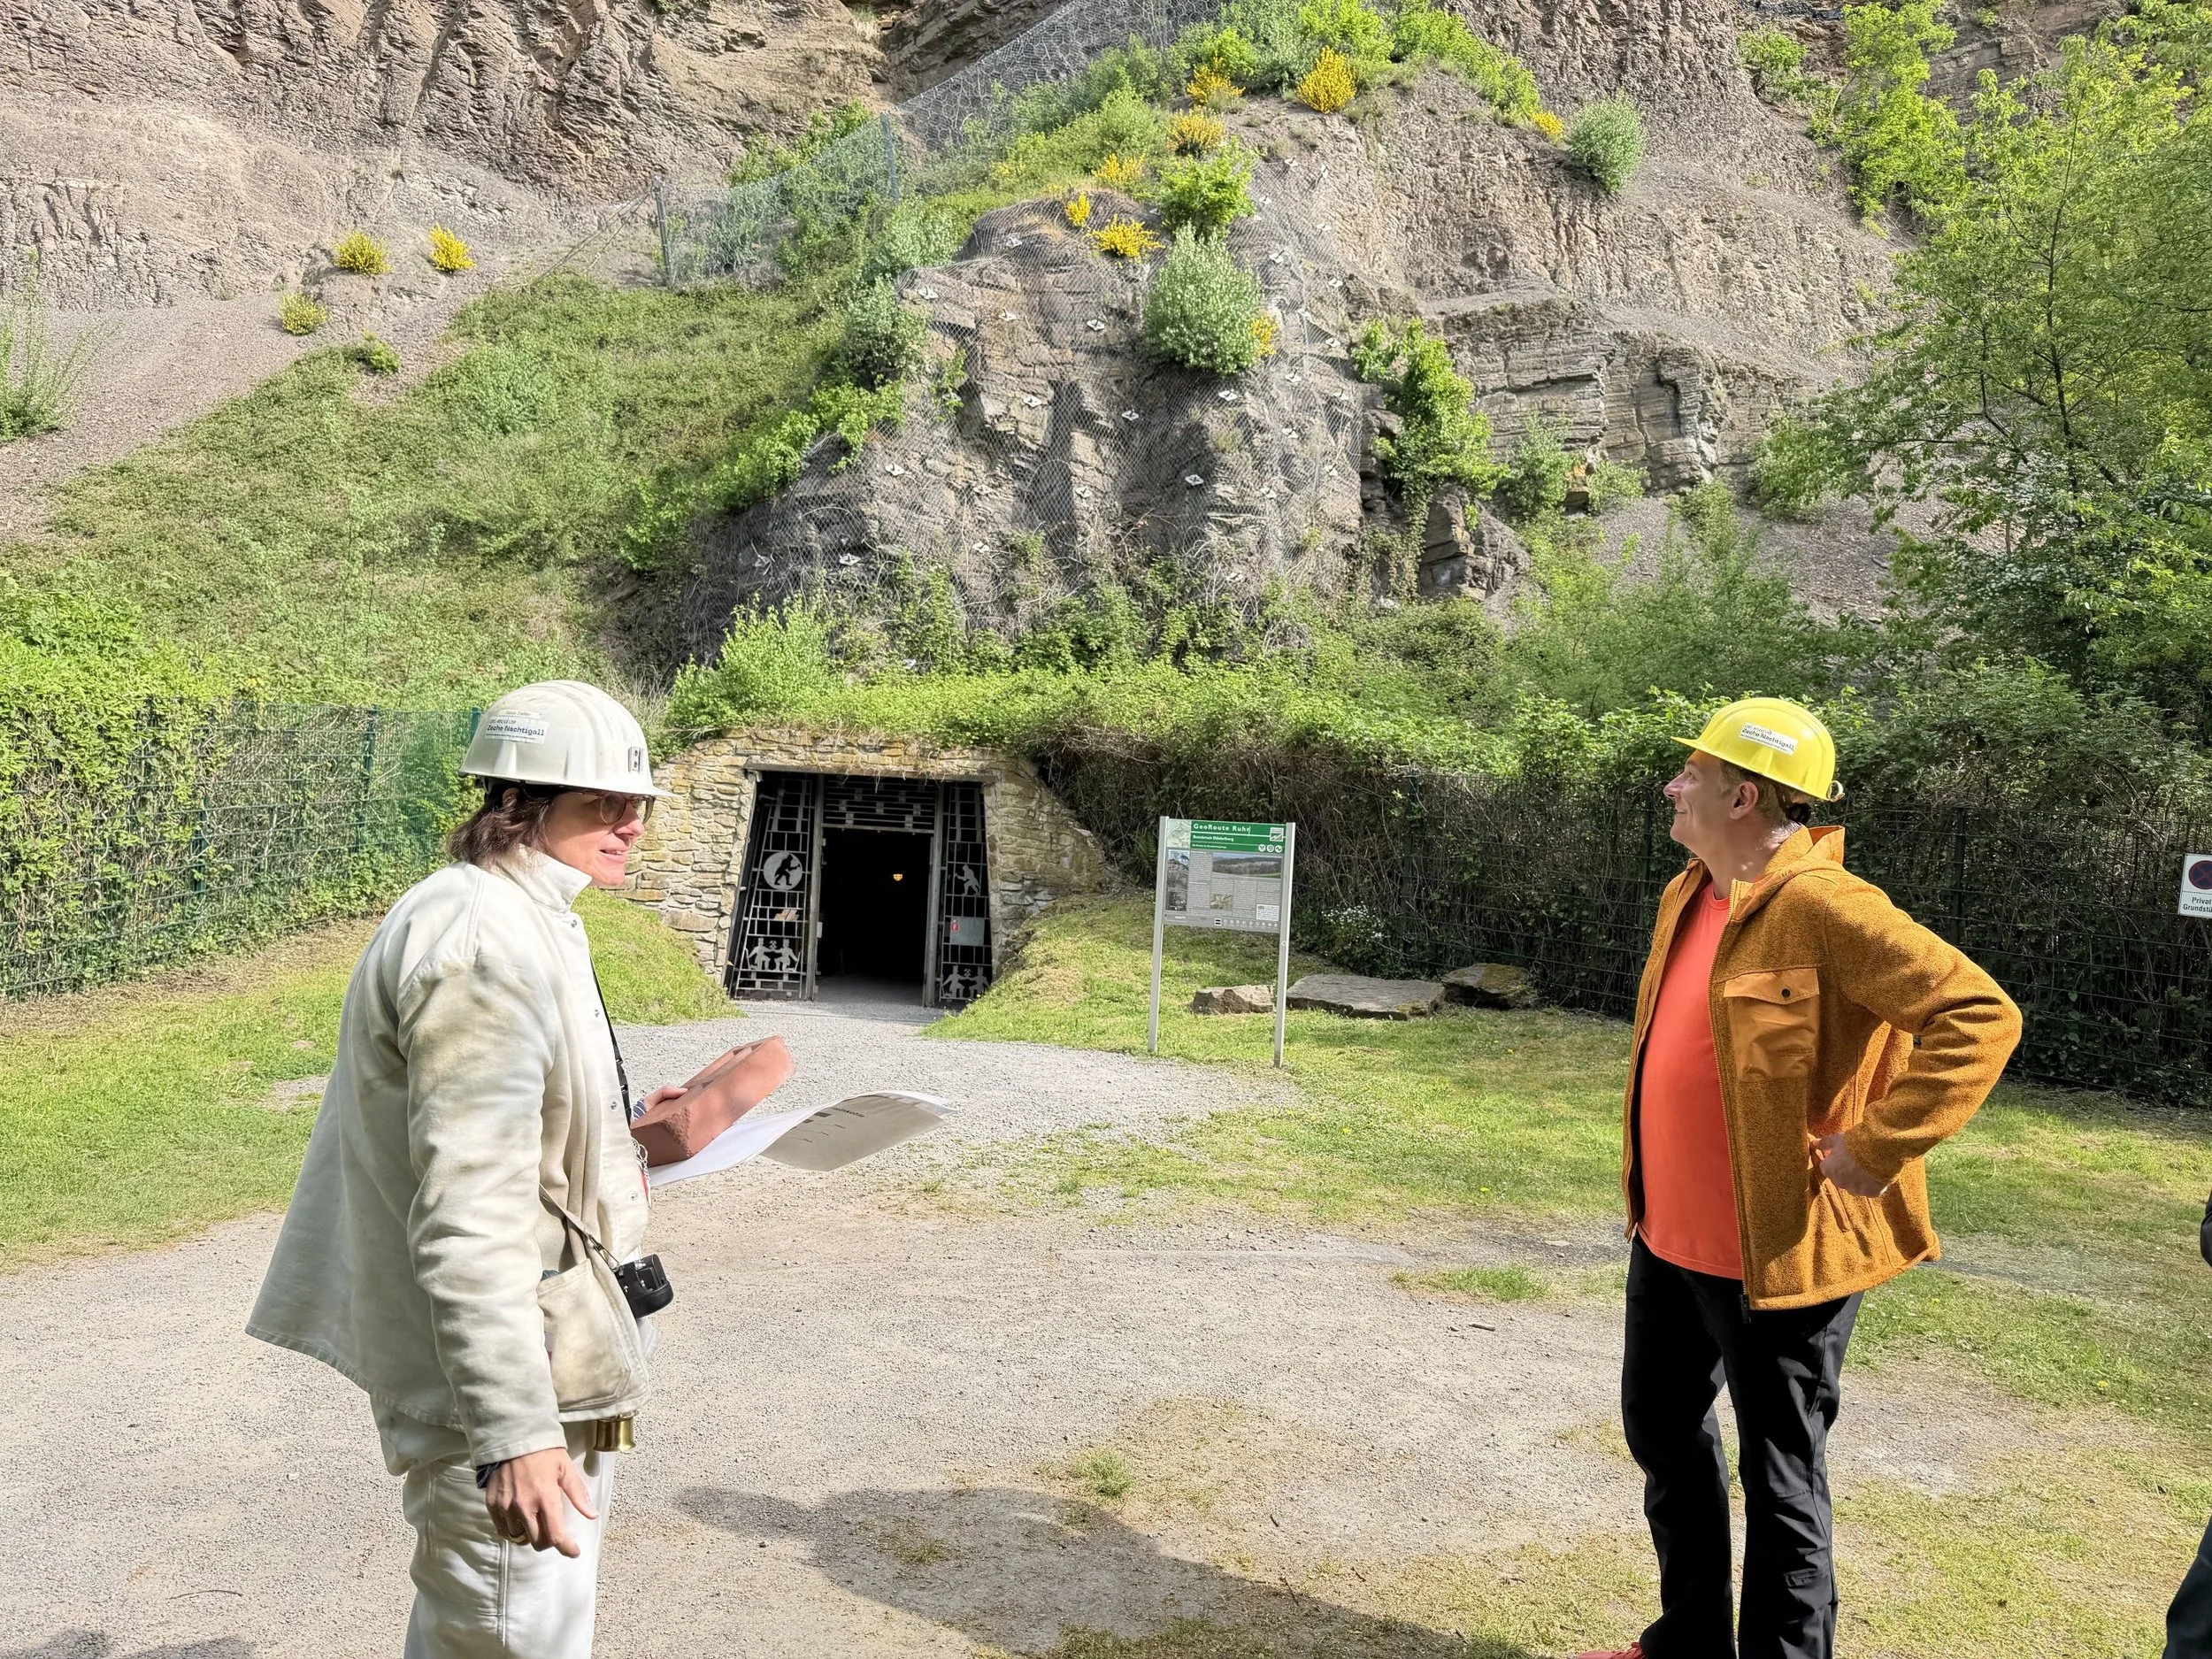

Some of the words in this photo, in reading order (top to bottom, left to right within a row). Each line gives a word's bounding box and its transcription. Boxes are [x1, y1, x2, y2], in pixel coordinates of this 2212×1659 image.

[504, 726, 545, 736] Nachtigall
[1761, 733, 1795, 751] Nachtigall
[1193, 823, 1230, 832] GeoRoute
[2192, 896, 2212, 905] Privat
